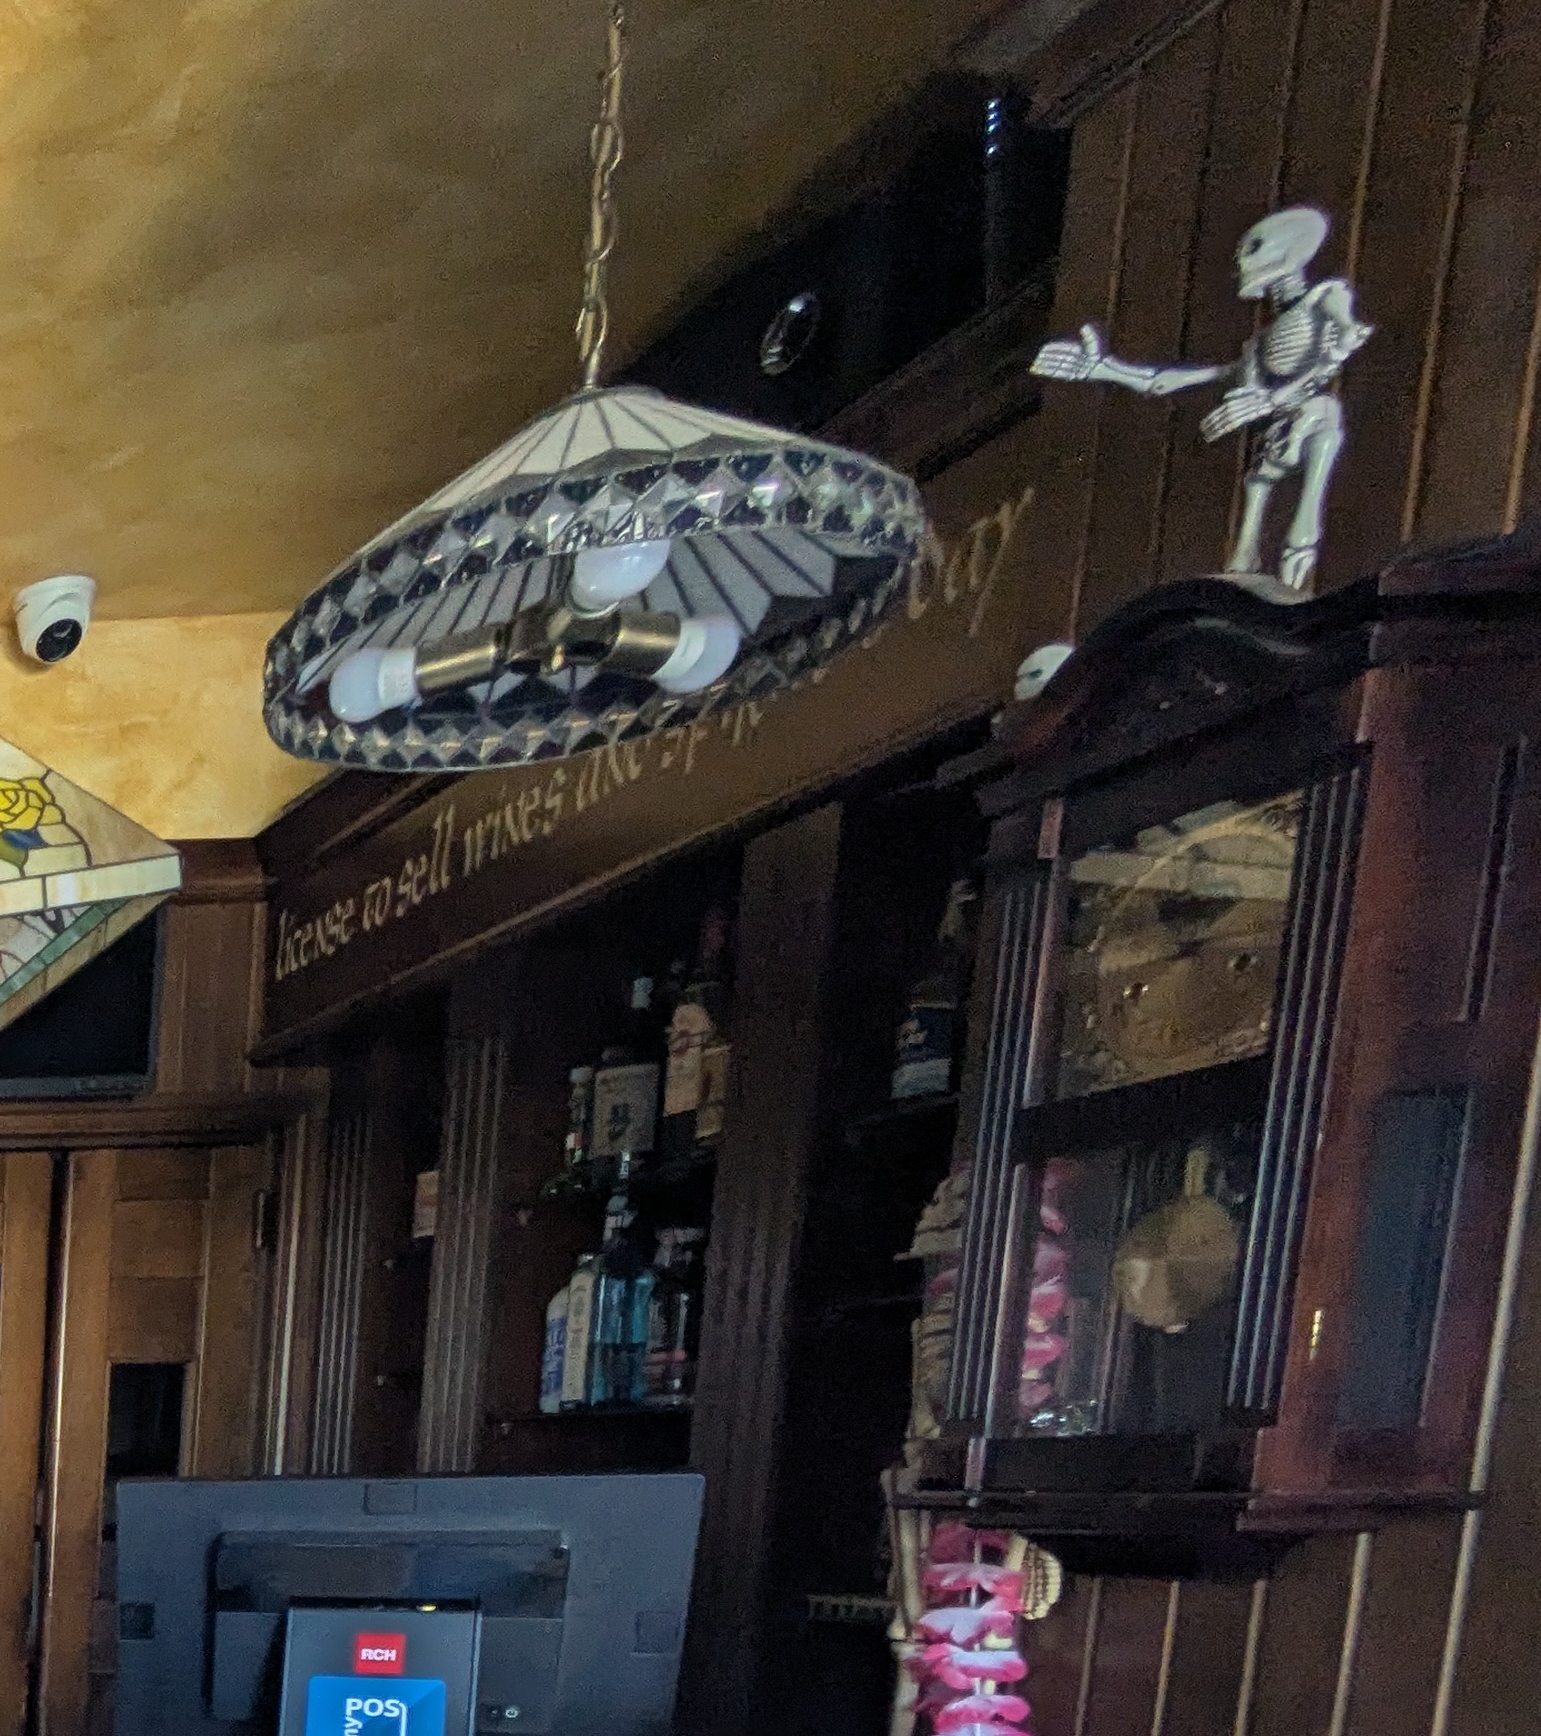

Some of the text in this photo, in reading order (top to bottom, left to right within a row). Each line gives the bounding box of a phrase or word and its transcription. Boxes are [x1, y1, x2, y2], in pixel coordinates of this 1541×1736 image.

[395, 803, 457, 918] sell
[360, 1648, 397, 1662] RCH
[345, 1698, 401, 1718] POS
